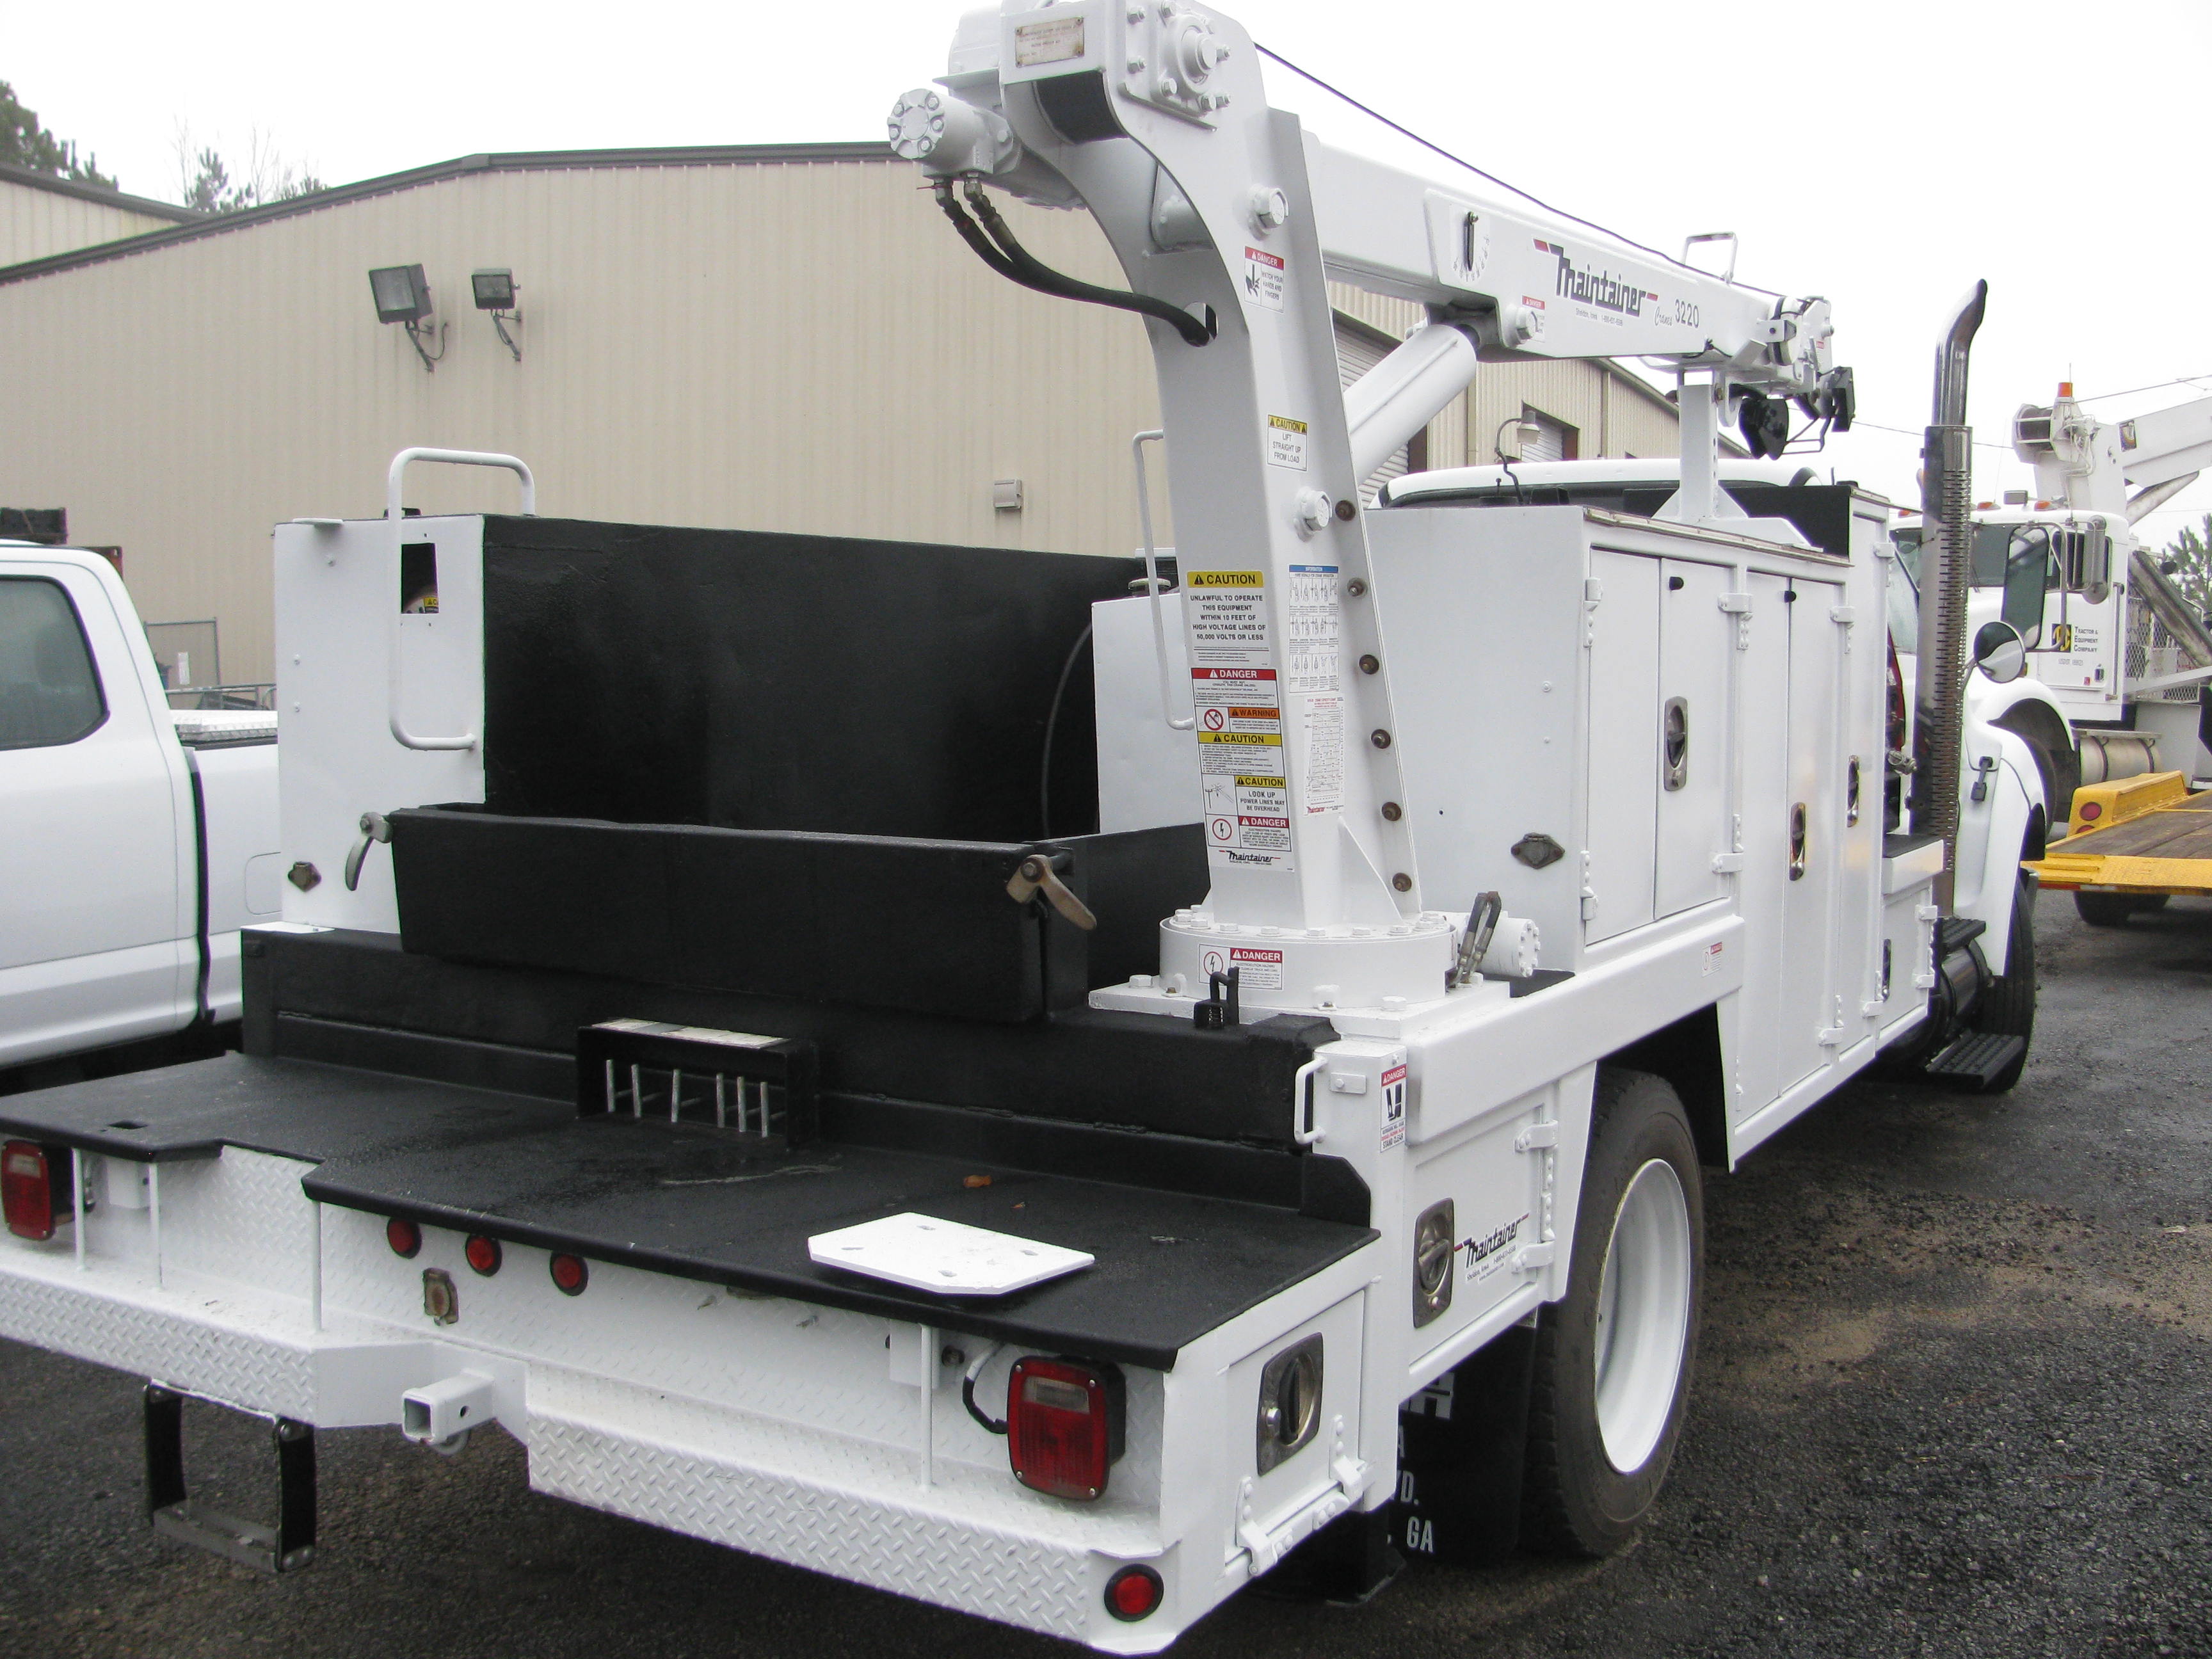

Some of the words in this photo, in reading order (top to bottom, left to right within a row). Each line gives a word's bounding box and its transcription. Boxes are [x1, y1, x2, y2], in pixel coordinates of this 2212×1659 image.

[1257, 252, 1278, 267] DANGER
[1549, 243, 1647, 317] Maintainer
[1262, 281, 1274, 290] HANDS
[1264, 290, 1279, 300] FINGERS
[1675, 298, 1699, 328] 3220
[1276, 419, 1301, 431] CAUTION
[1282, 432, 1292, 442] LIFT
[1272, 441, 1295, 452] STRAIGHT
[1274, 451, 1287, 461] FROM
[1287, 454, 1300, 463] LOAD
[1206, 574, 1256, 584] CAUTION
[2074, 635, 2098, 643] EQUIPMENT
[1219, 669, 1258, 678] DANGER
[1223, 734, 1265, 743] CAUTION
[1245, 777, 1283, 787] CAUTION
[1251, 817, 1286, 827] DANGER
[1226, 849, 1274, 863] Maintainer
[1242, 951, 1281, 961] DANGER
[1386, 1067, 1406, 1084] DANGER
[1463, 1218, 1521, 1269] Maintainer
[1406, 1516, 1434, 1553] GA
